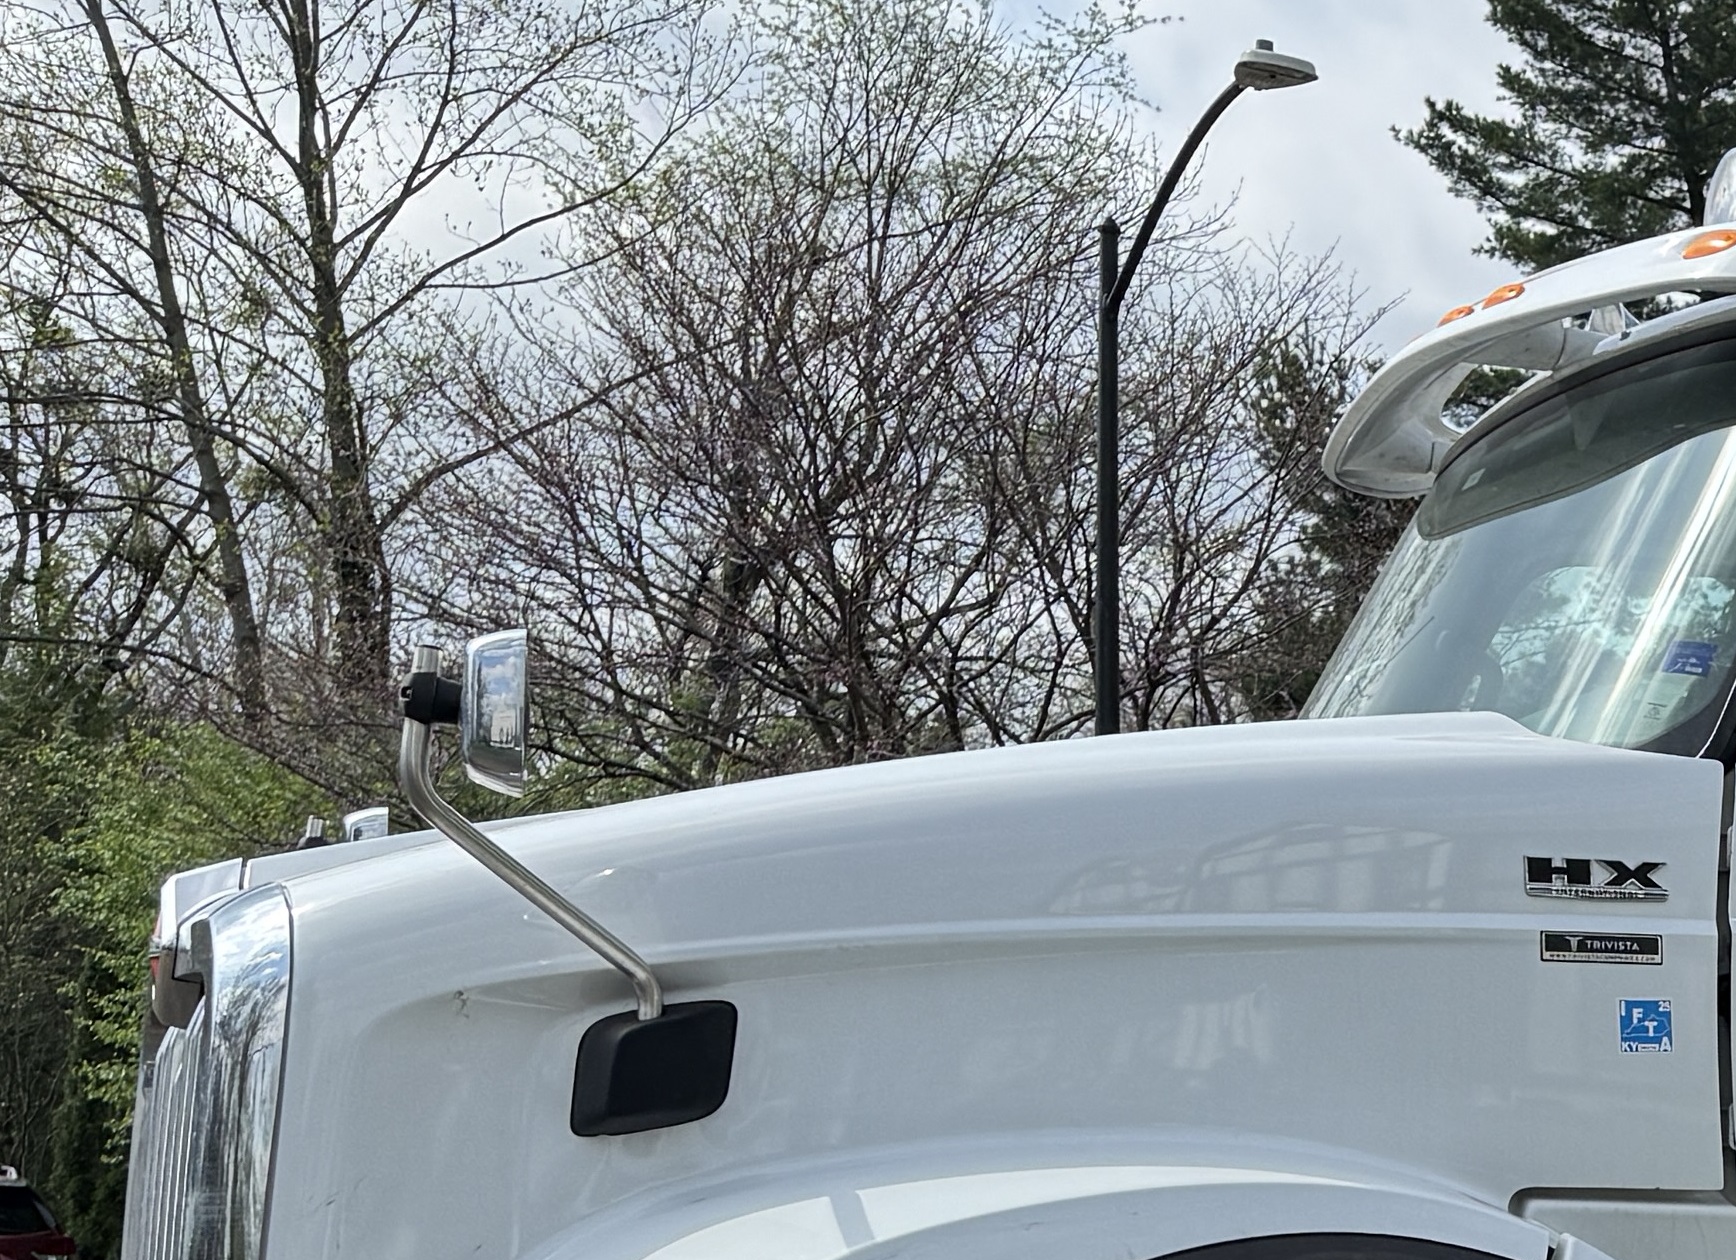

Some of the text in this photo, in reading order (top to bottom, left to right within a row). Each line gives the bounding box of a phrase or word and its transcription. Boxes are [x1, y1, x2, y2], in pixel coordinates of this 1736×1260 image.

[1524, 855, 1668, 888] HX
[1585, 940, 1640, 951] TRIVISTA
[1621, 1036, 1671, 1052] KY A
